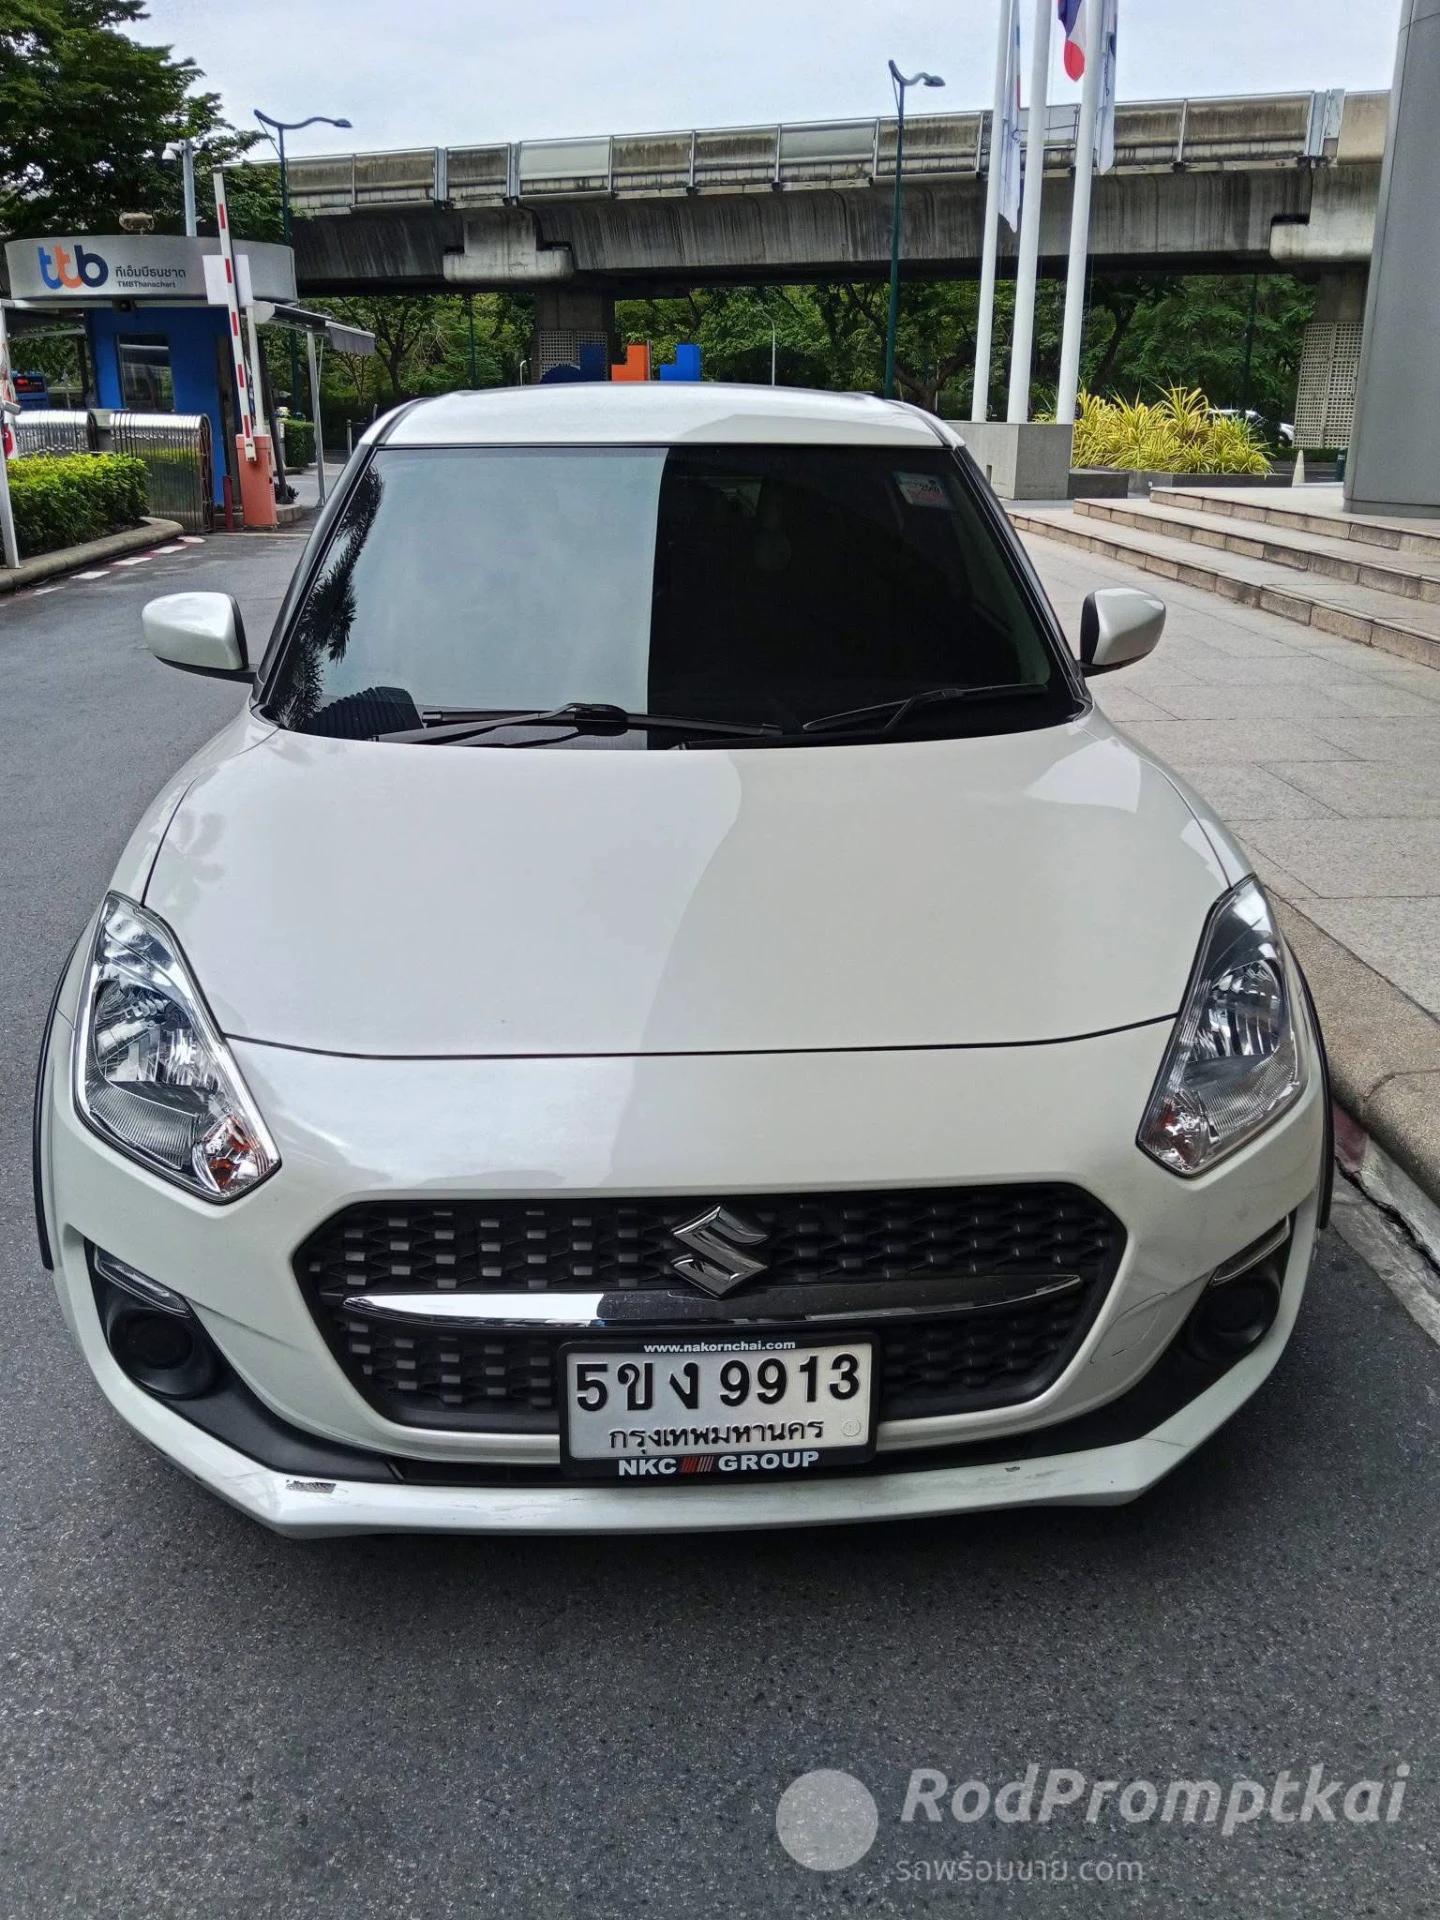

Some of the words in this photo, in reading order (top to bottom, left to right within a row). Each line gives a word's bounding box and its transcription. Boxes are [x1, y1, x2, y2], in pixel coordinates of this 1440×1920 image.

[38, 244, 108, 290] ttb
[643, 1341, 796, 1353] www.nakornchai.com
[719, 1353, 861, 1407] 9913
[609, 1420, 823, 1454] กรุงเทพมหานคร
[618, 1458, 677, 1476] NKC
[718, 1451, 820, 1472] GROUP
